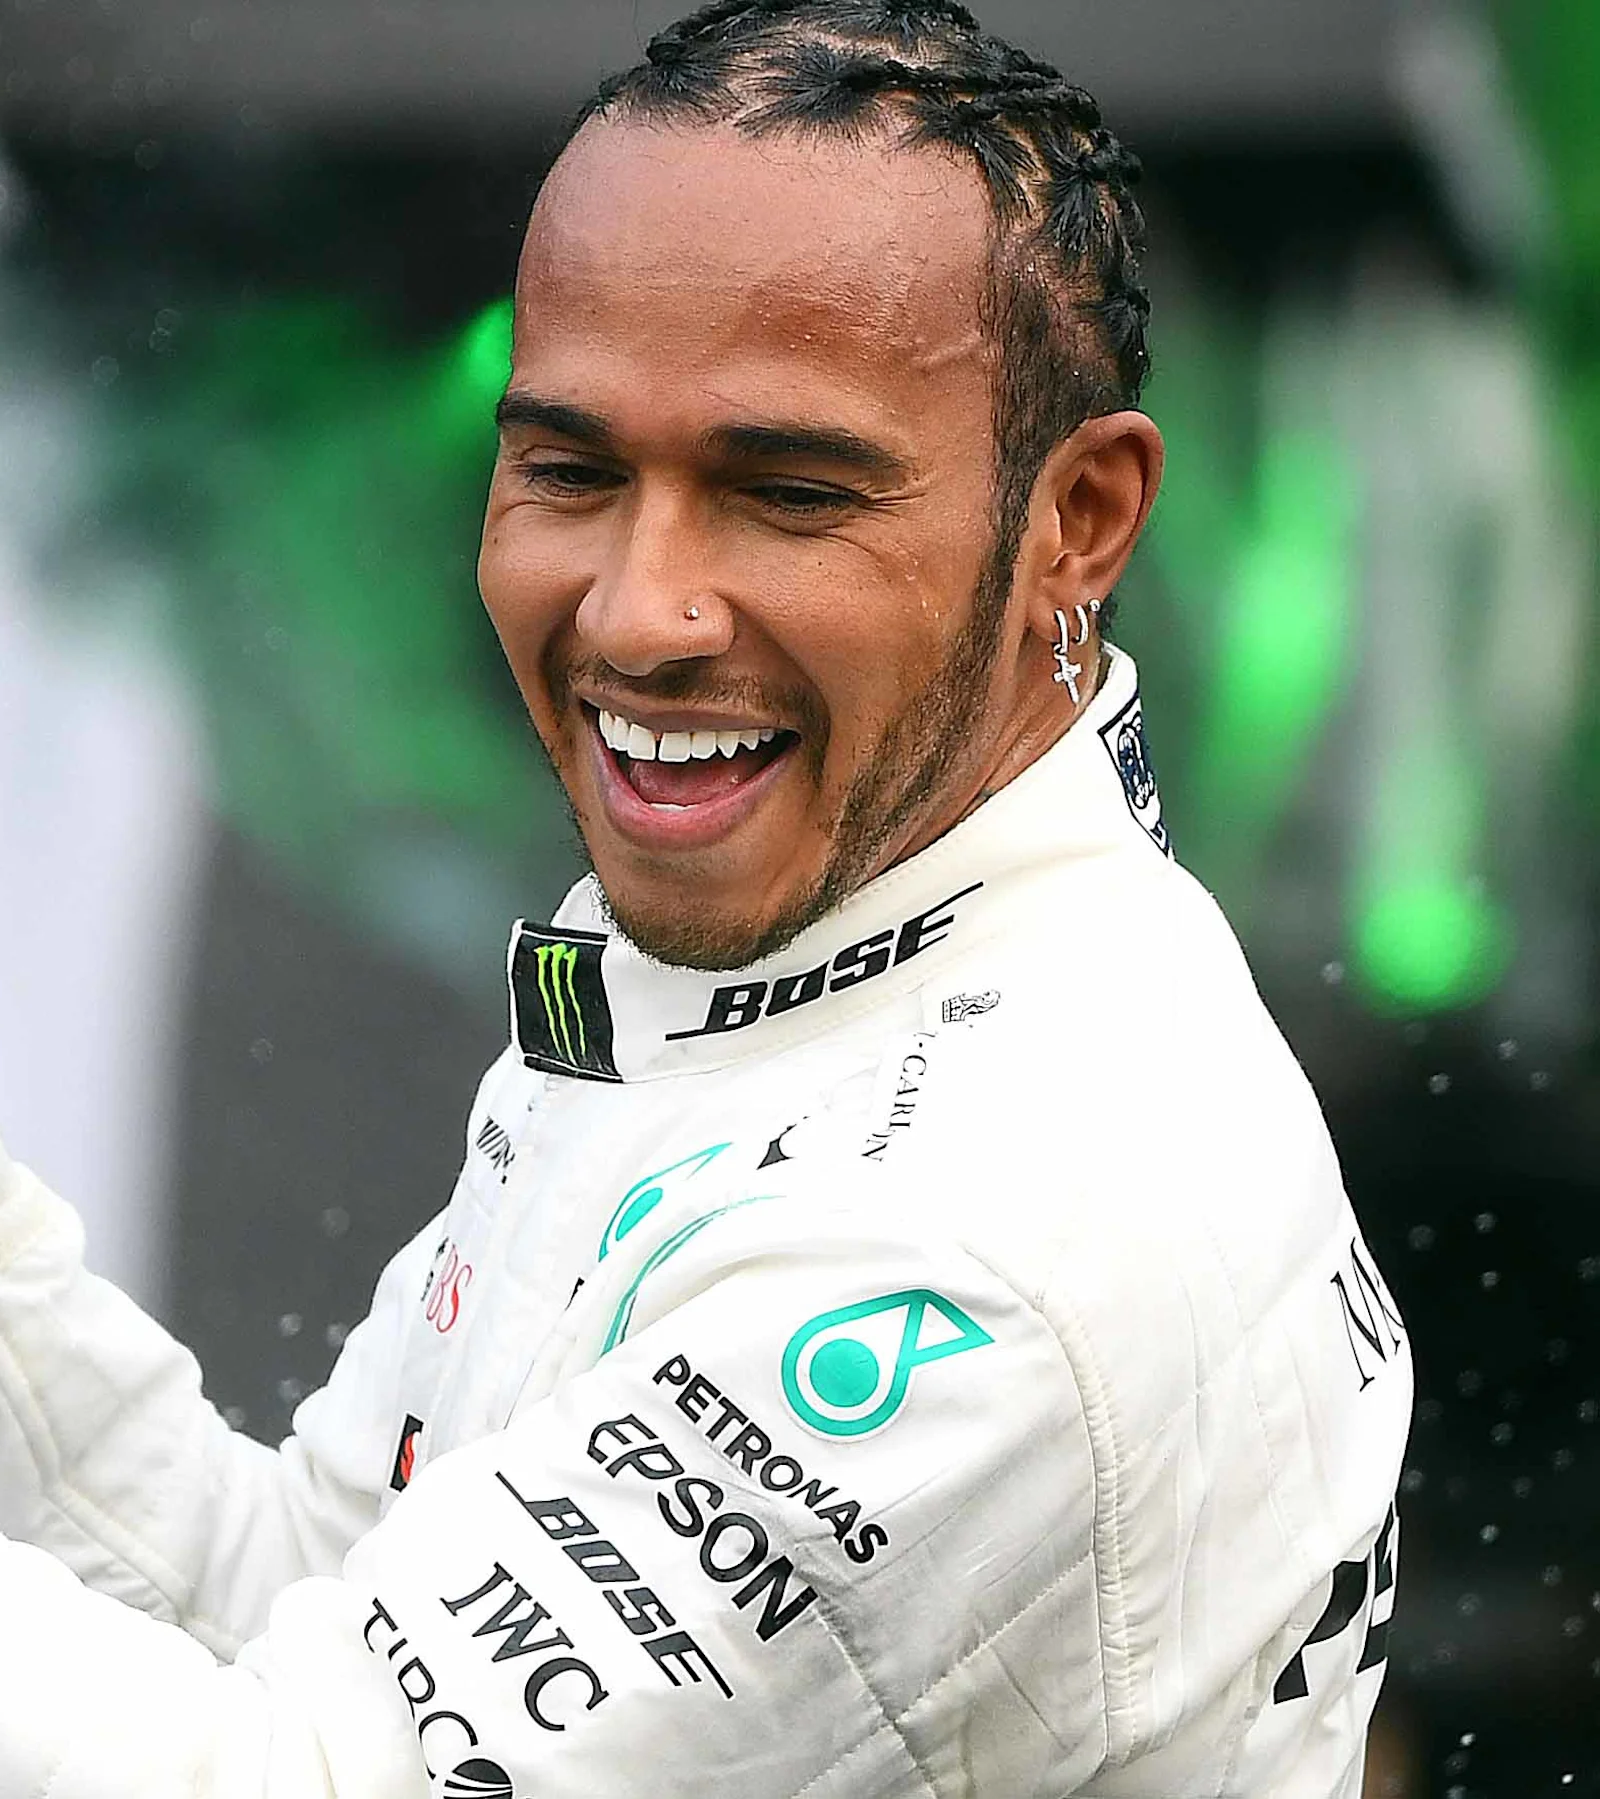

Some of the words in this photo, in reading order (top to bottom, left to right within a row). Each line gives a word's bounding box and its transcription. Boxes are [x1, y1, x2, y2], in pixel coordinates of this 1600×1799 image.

[665, 882, 984, 1042] BOSE
[586, 1412, 818, 1643] EPSON
[652, 1353, 890, 1565] PETRONAS
[439, 1561, 610, 1731] IWC
[495, 1470, 735, 1699] BOSE
